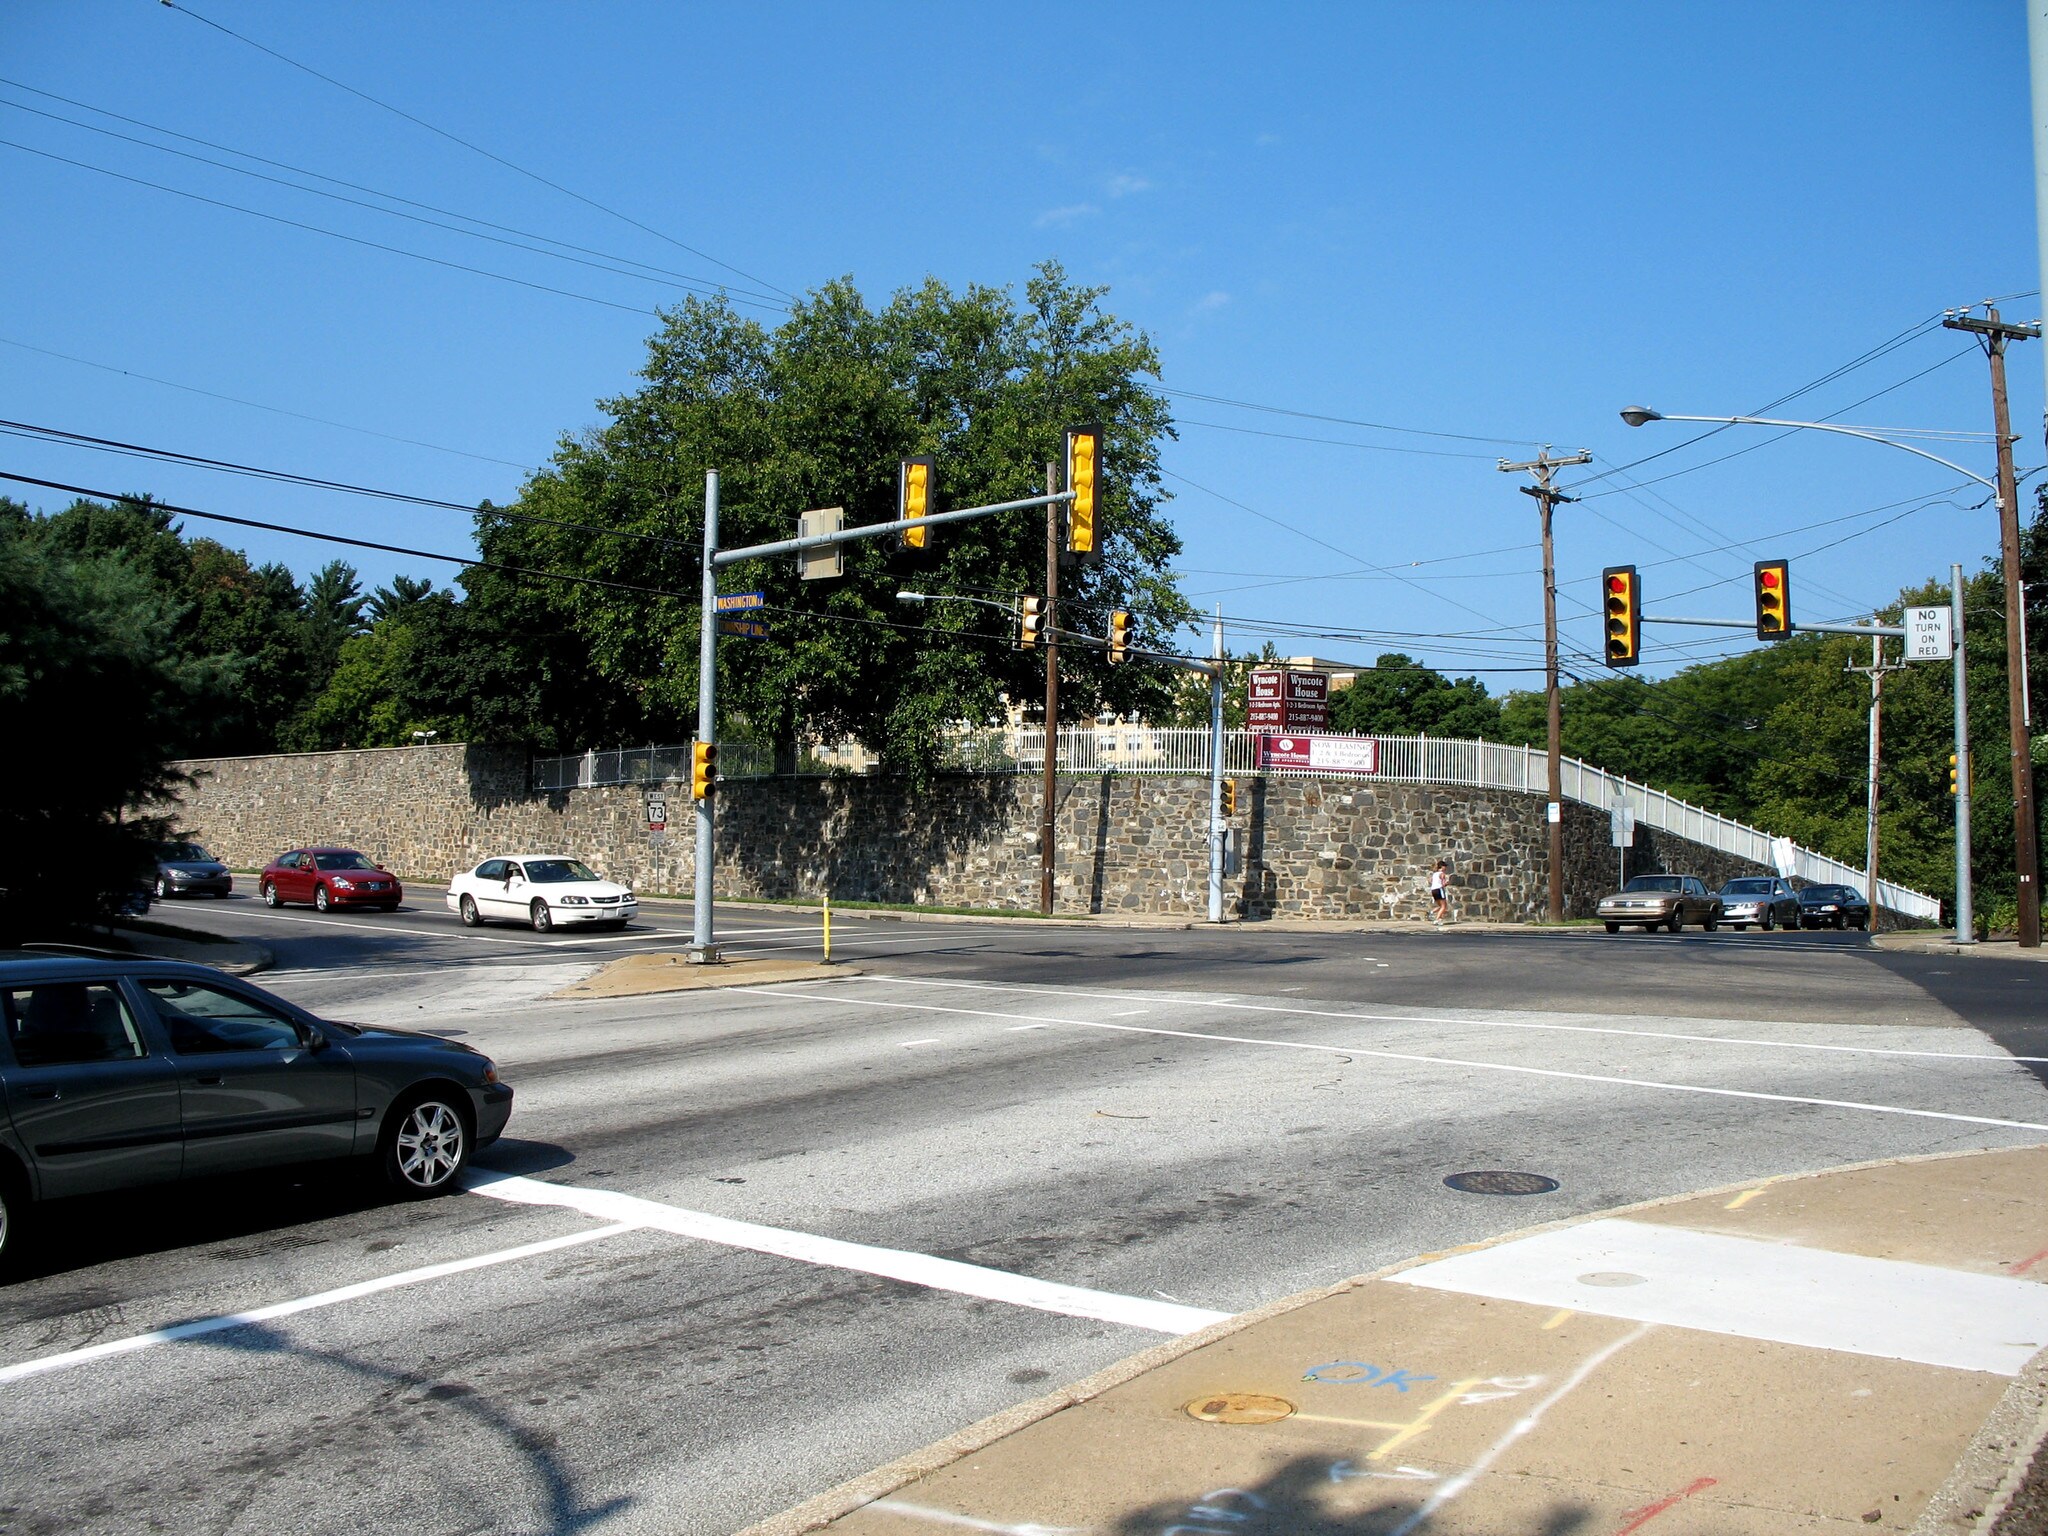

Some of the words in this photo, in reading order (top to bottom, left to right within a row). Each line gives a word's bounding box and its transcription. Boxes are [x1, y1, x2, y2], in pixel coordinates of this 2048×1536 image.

[717, 595, 757, 610] WASHINGTON
[1918, 610, 1936, 620] NO
[1915, 623, 1941, 632] TURN
[1921, 635, 1935, 643] ON
[1918, 646, 1938, 655] RED
[1252, 674, 1278, 686] Wyncote
[1290, 674, 1323, 687] Wyncote
[1255, 686, 1274, 696] House
[1295, 687, 1318, 697] House
[1288, 713, 1324, 722] 215-887-9400
[1334, 742, 1371, 751] LEASING
[1263, 750, 1291, 759] Wyncote
[1291, 752, 1309, 760] House
[650, 807, 663, 818] 73
[1307, 1361, 1436, 1393] OK
